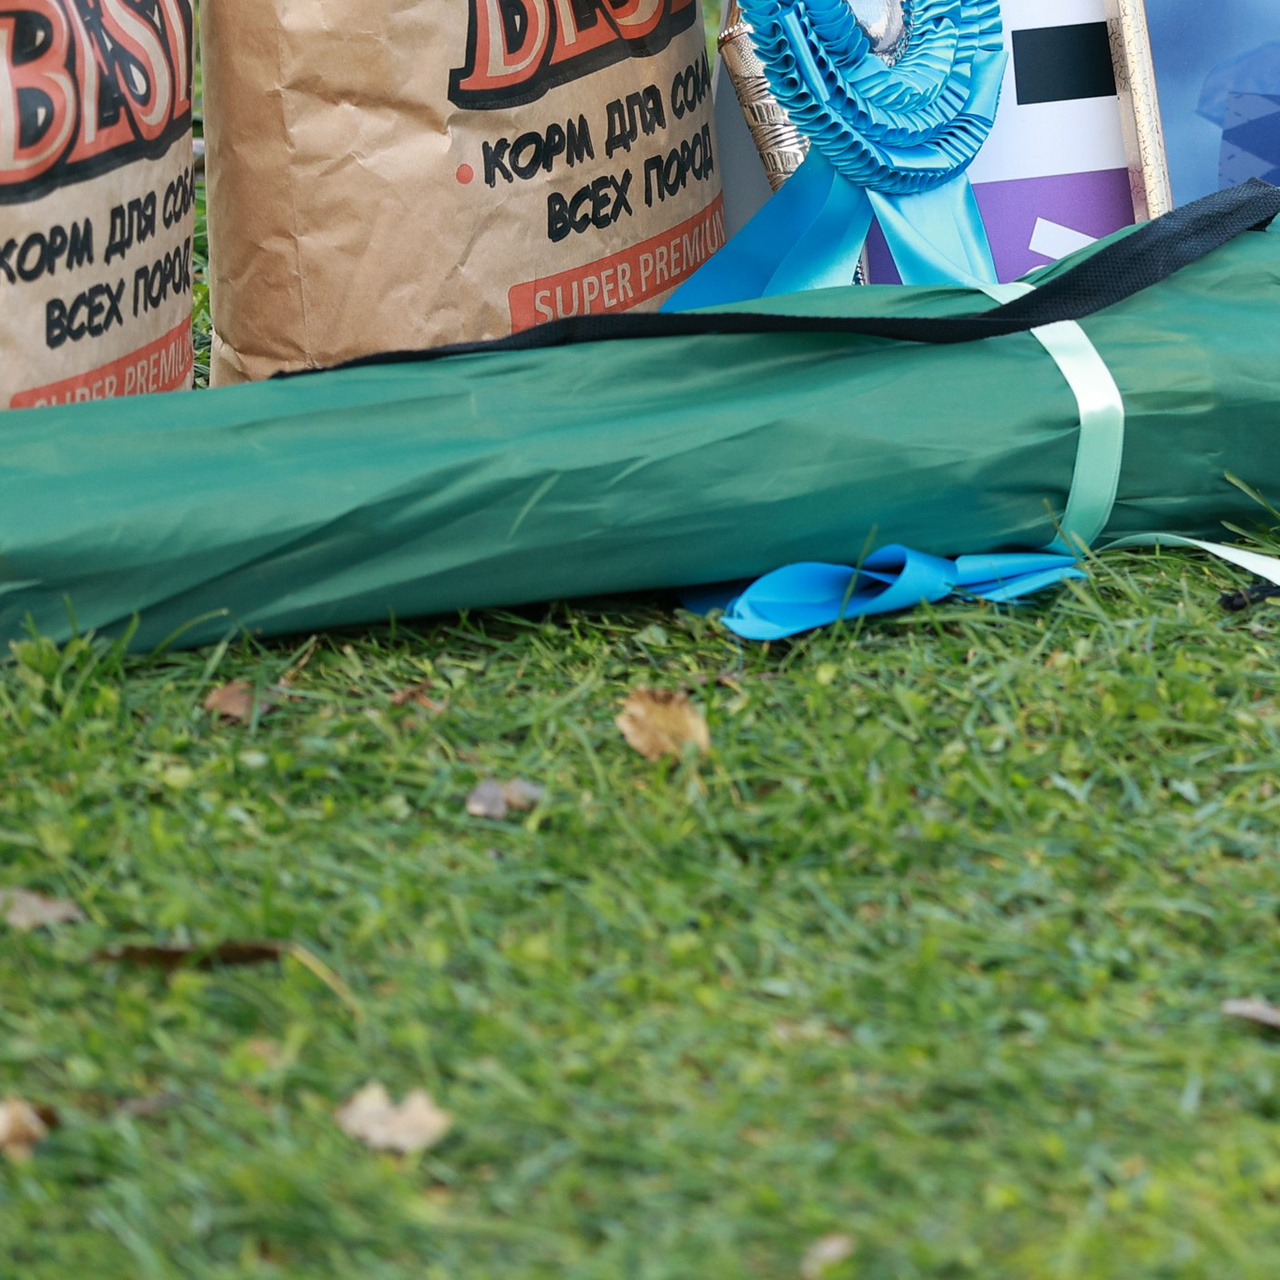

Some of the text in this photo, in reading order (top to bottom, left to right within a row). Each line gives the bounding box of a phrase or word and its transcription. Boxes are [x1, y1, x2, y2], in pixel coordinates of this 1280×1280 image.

[482, 114, 594, 188] КОРМ
[605, 84, 666, 160] ДЛЯ
[547, 123, 714, 242] ВСЕХ ПОРОД
[104, 191, 157, 266] ДЛЯ
[46, 279, 124, 350] ВСЕХ
[534, 263, 633, 324] SUPER
